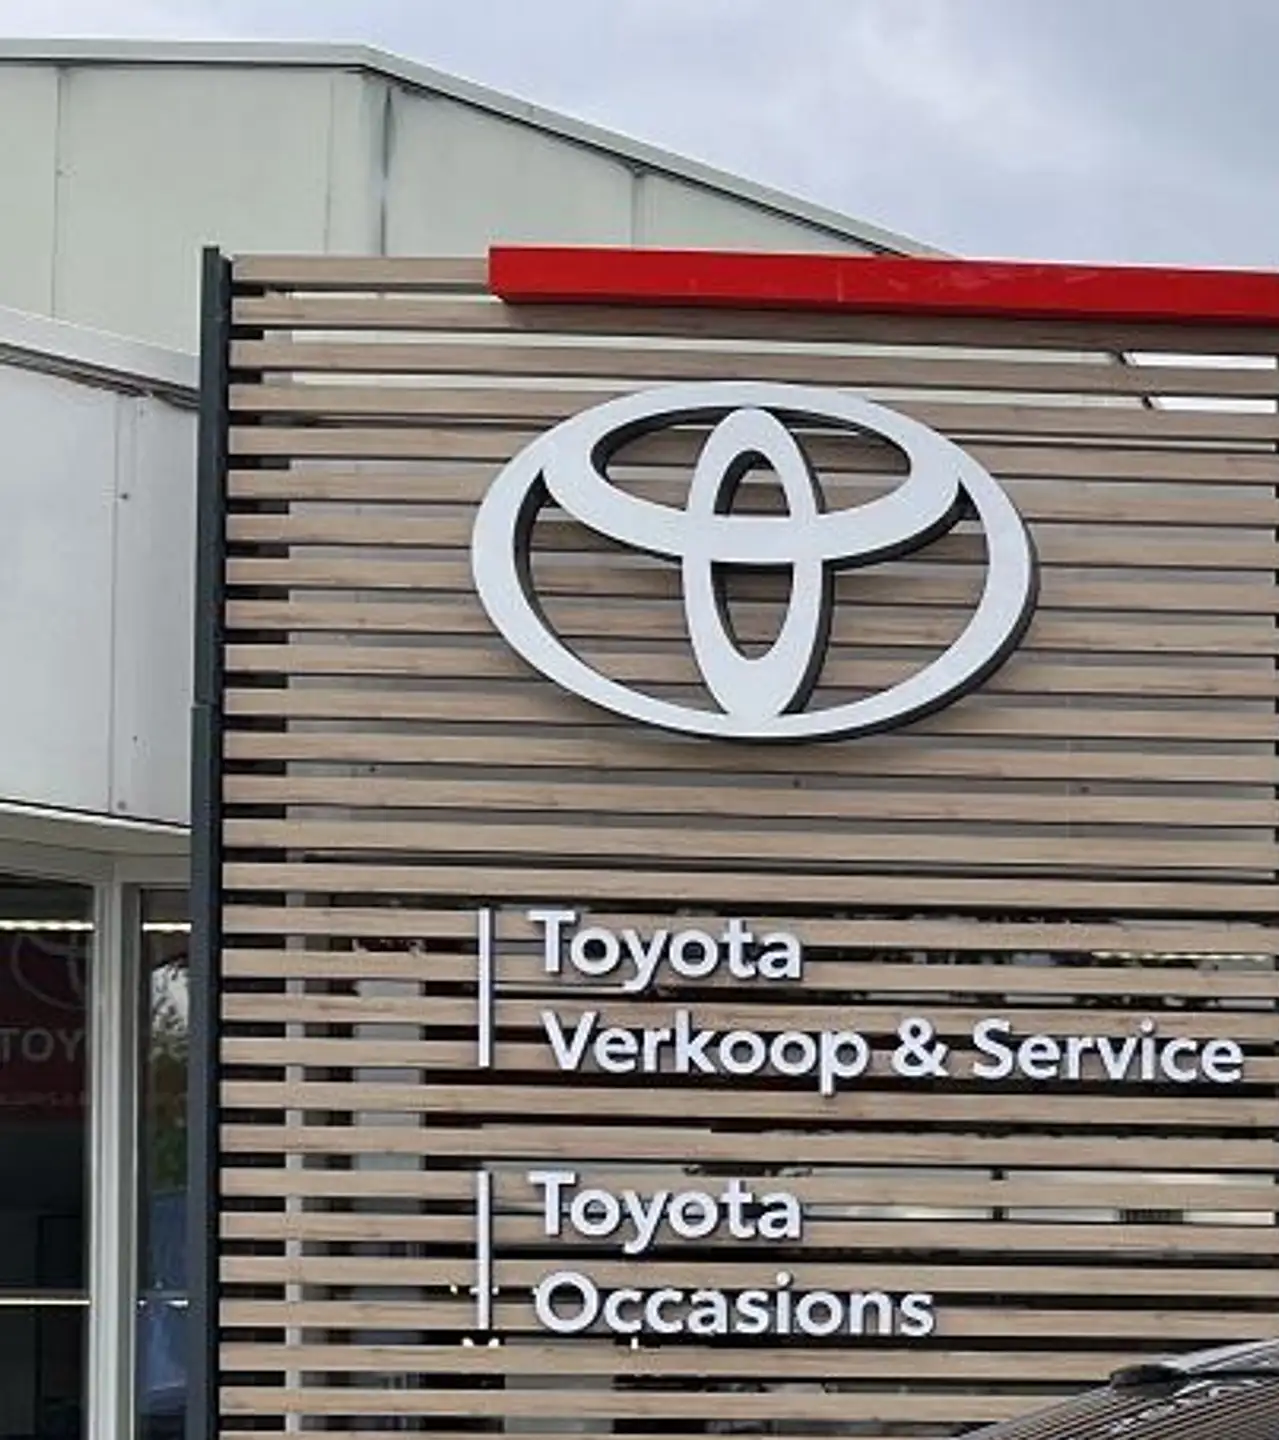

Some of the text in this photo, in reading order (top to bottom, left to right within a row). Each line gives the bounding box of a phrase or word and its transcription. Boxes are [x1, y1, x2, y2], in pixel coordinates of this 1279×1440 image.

[528, 910, 803, 990] Toyota
[542, 1010, 1244, 1096] Verkoop & Service
[528, 1171, 803, 1252] Toyota
[535, 1271, 935, 1338] Occasions
